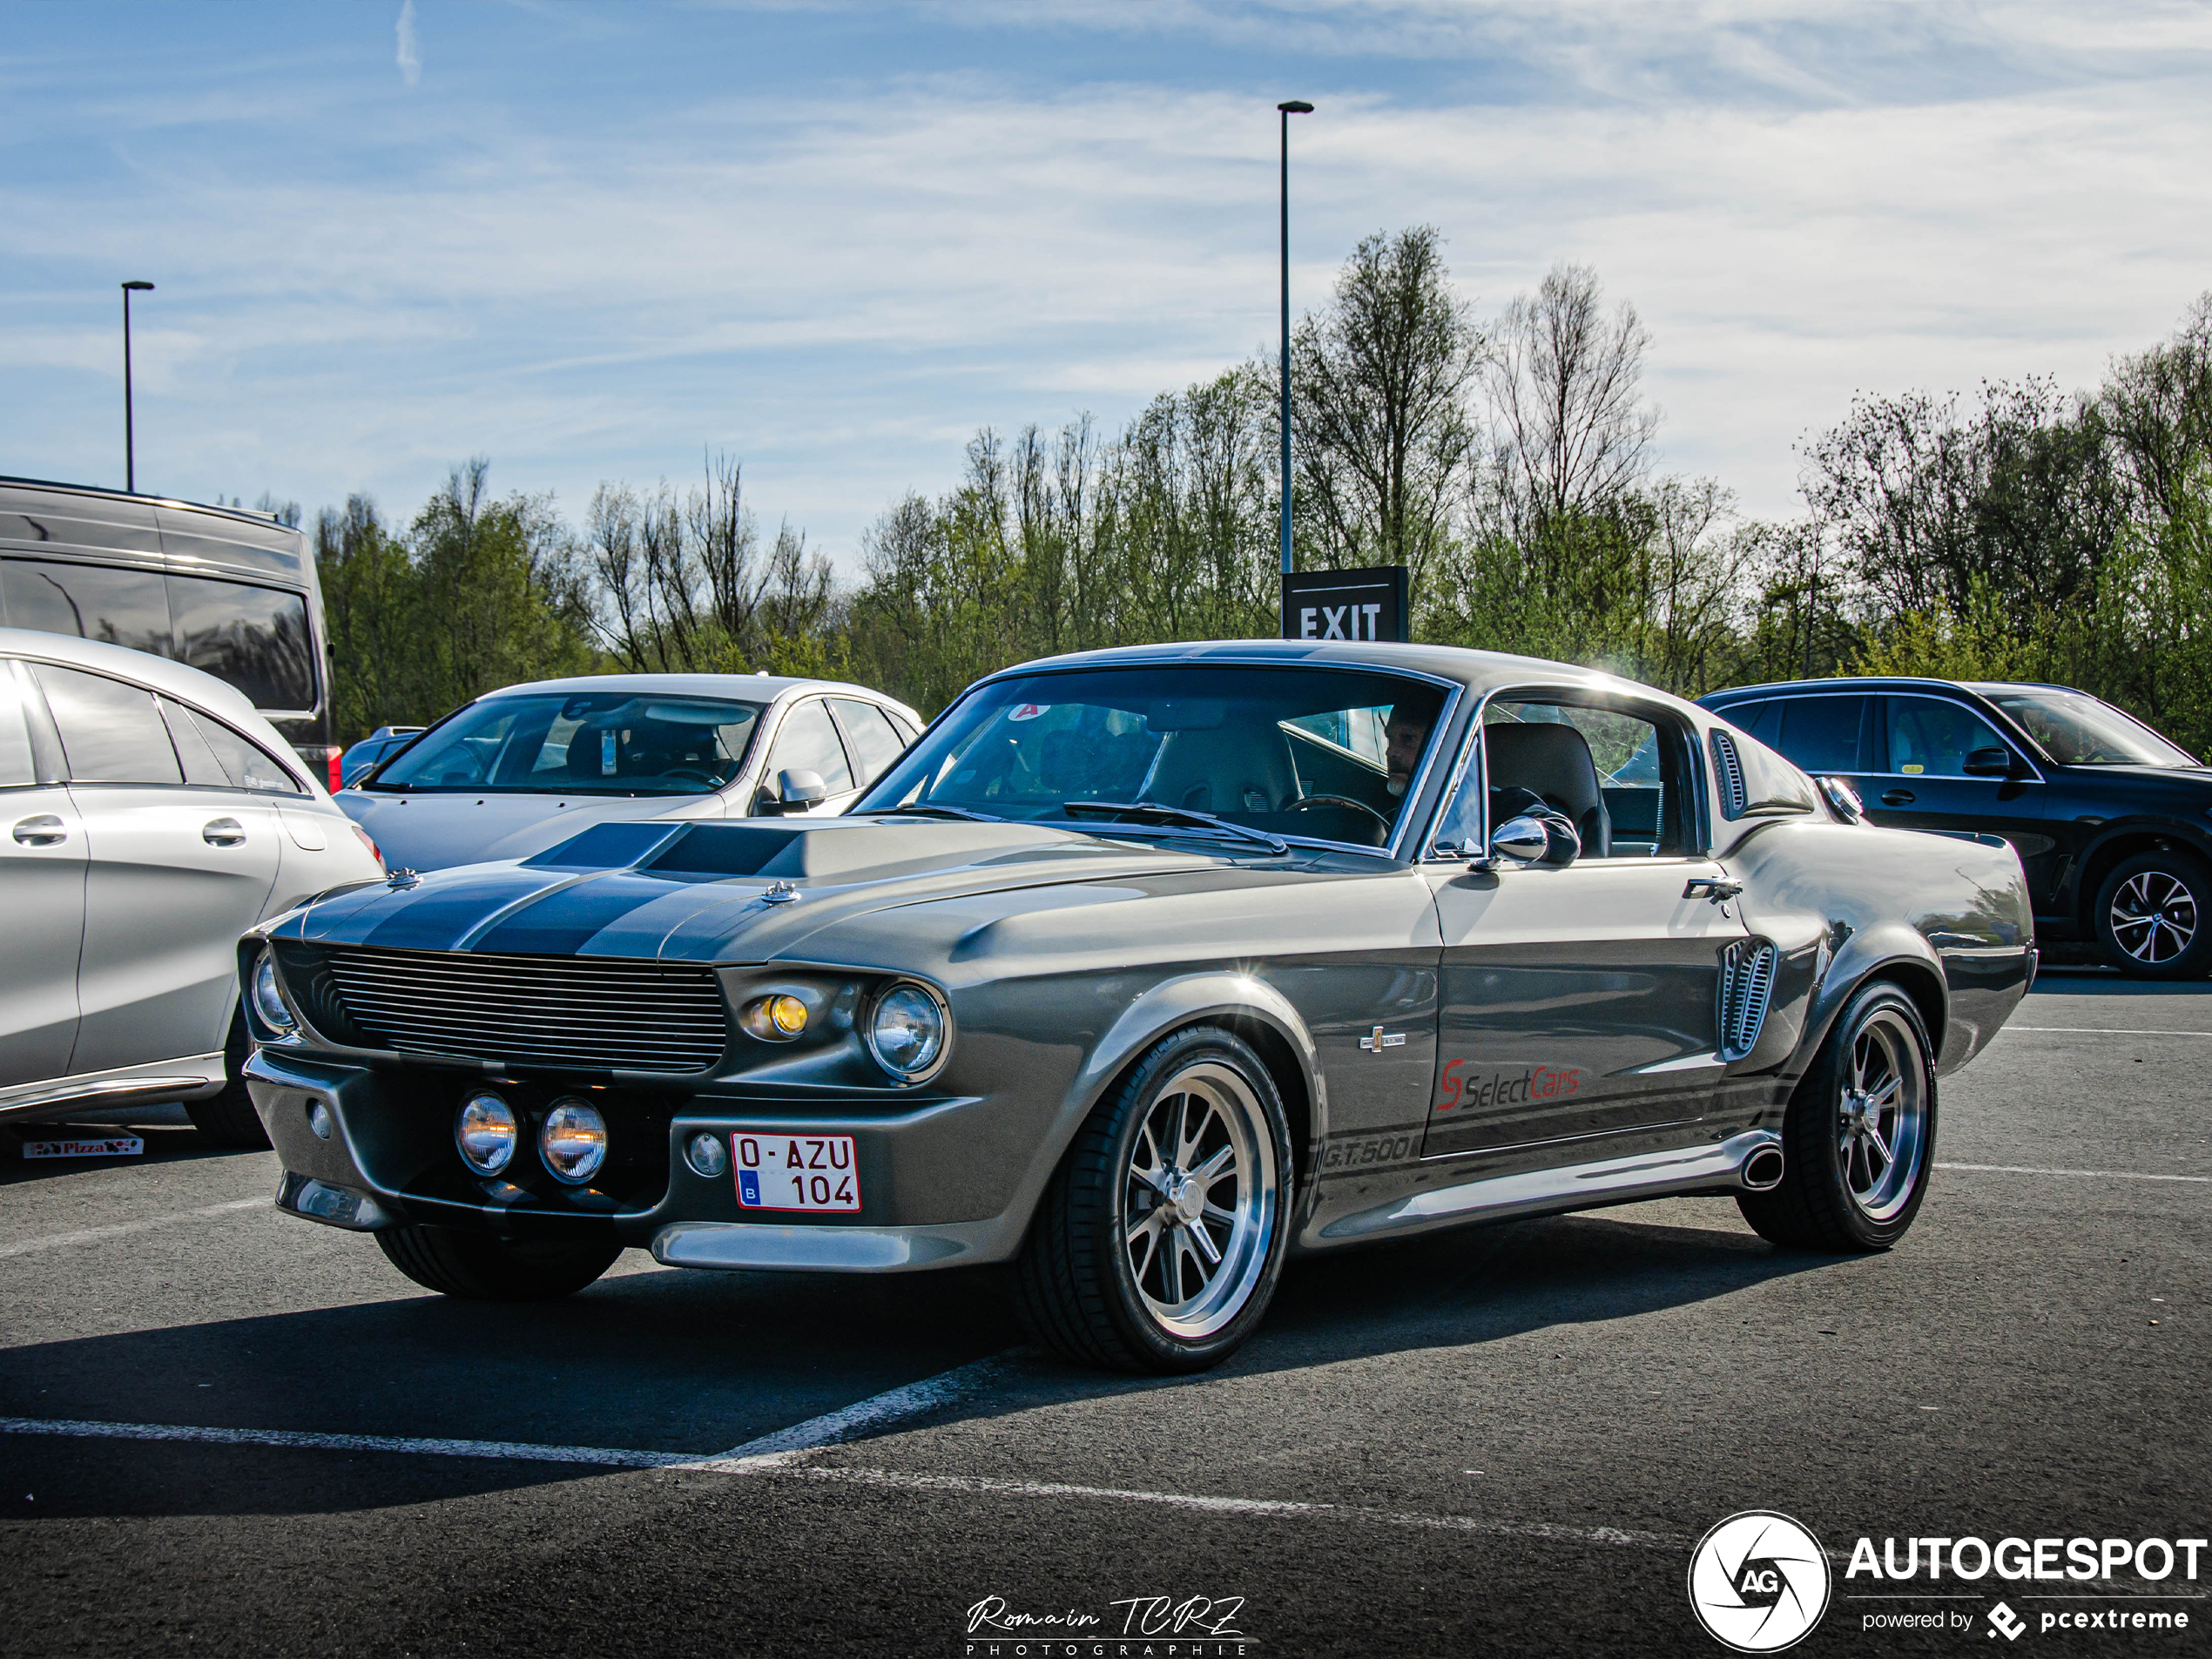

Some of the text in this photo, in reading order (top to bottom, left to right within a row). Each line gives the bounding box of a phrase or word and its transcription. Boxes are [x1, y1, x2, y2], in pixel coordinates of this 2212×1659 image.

[1300, 604, 1380, 641] EXIT
[1015, 704, 1038, 718] A
[1460, 1066, 1580, 1109] SelectCars
[64, 1142, 105, 1154] Pizza
[745, 1188, 756, 1199] B
[792, 1176, 853, 1204] 104
